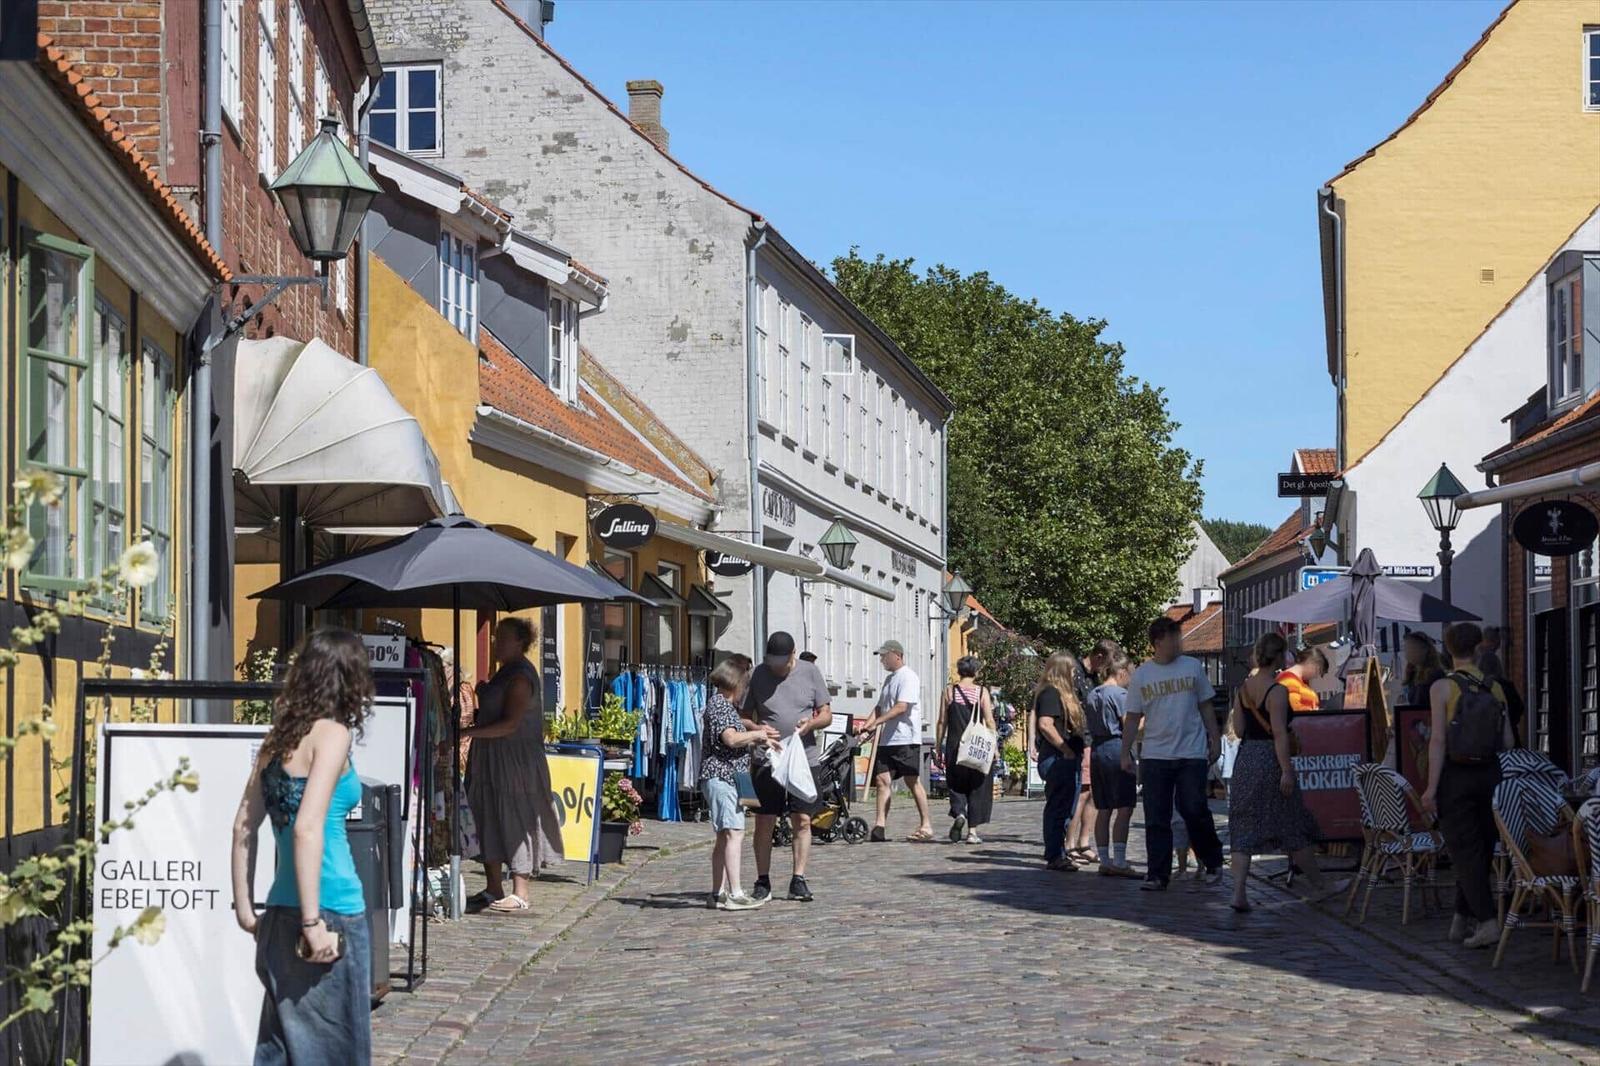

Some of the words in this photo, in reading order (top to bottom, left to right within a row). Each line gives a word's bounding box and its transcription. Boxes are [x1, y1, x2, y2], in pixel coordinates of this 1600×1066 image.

[600, 518, 650, 537] Salling
[368, 645, 400, 662] 50%
[101, 859, 201, 881] GALLERI
[101, 887, 220, 910] EBELTOFT
